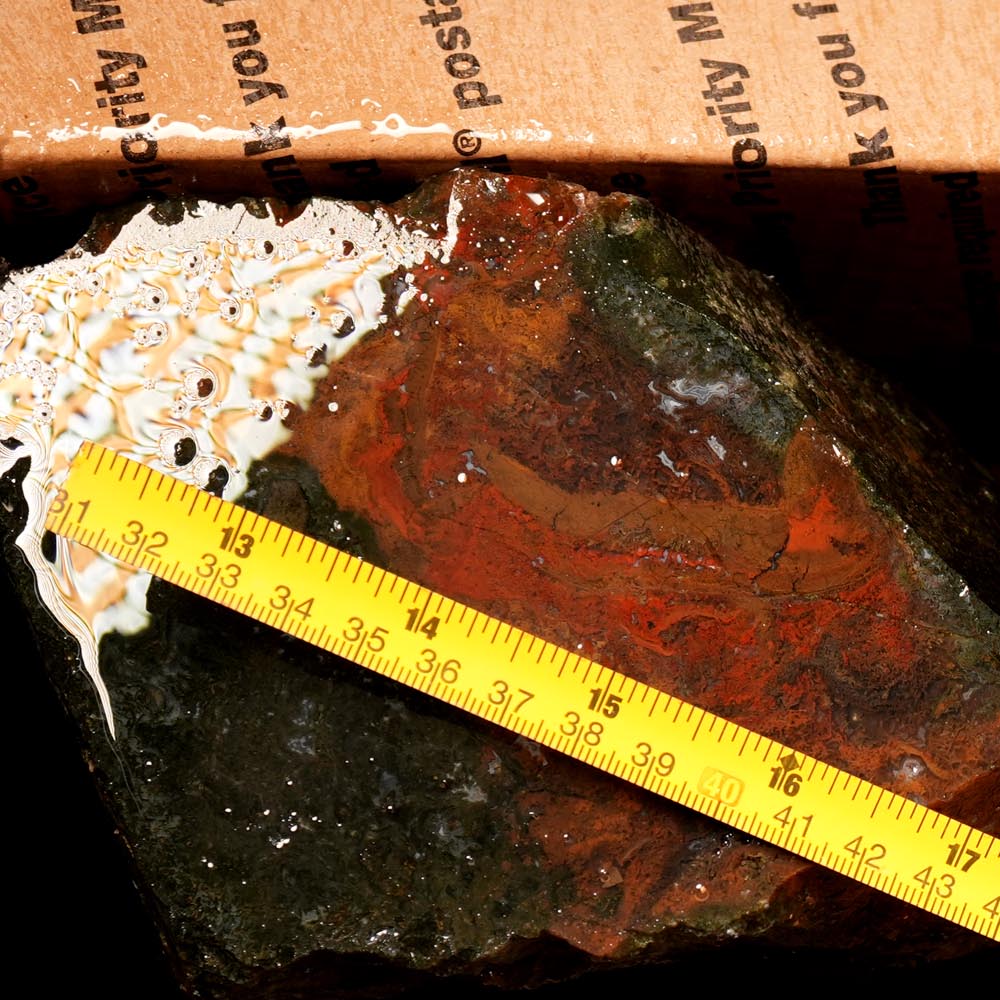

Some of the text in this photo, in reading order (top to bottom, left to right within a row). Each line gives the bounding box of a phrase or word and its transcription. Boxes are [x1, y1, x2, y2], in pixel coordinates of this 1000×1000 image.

[222, 19, 289, 107] you
[817, 34, 889, 117] you
[121, 520, 168, 558] 32
[196, 553, 242, 588] 33
[269, 585, 315, 620] 34
[342, 616, 389, 653] 35
[415, 649, 461, 684] 36
[487, 680, 534, 713] 37
[560, 711, 604, 746] 38
[631, 742, 675, 777] 39
[700, 770, 744, 806] 40
[773, 805, 814, 838] 41
[843, 835, 887, 870] 42
[913, 865, 956, 899] 43
[219, 527, 255, 559] 13
[405, 607, 441, 640] 14
[587, 688, 623, 719] 15
[768, 767, 803, 797] 16
[945, 843, 981, 873] 17
